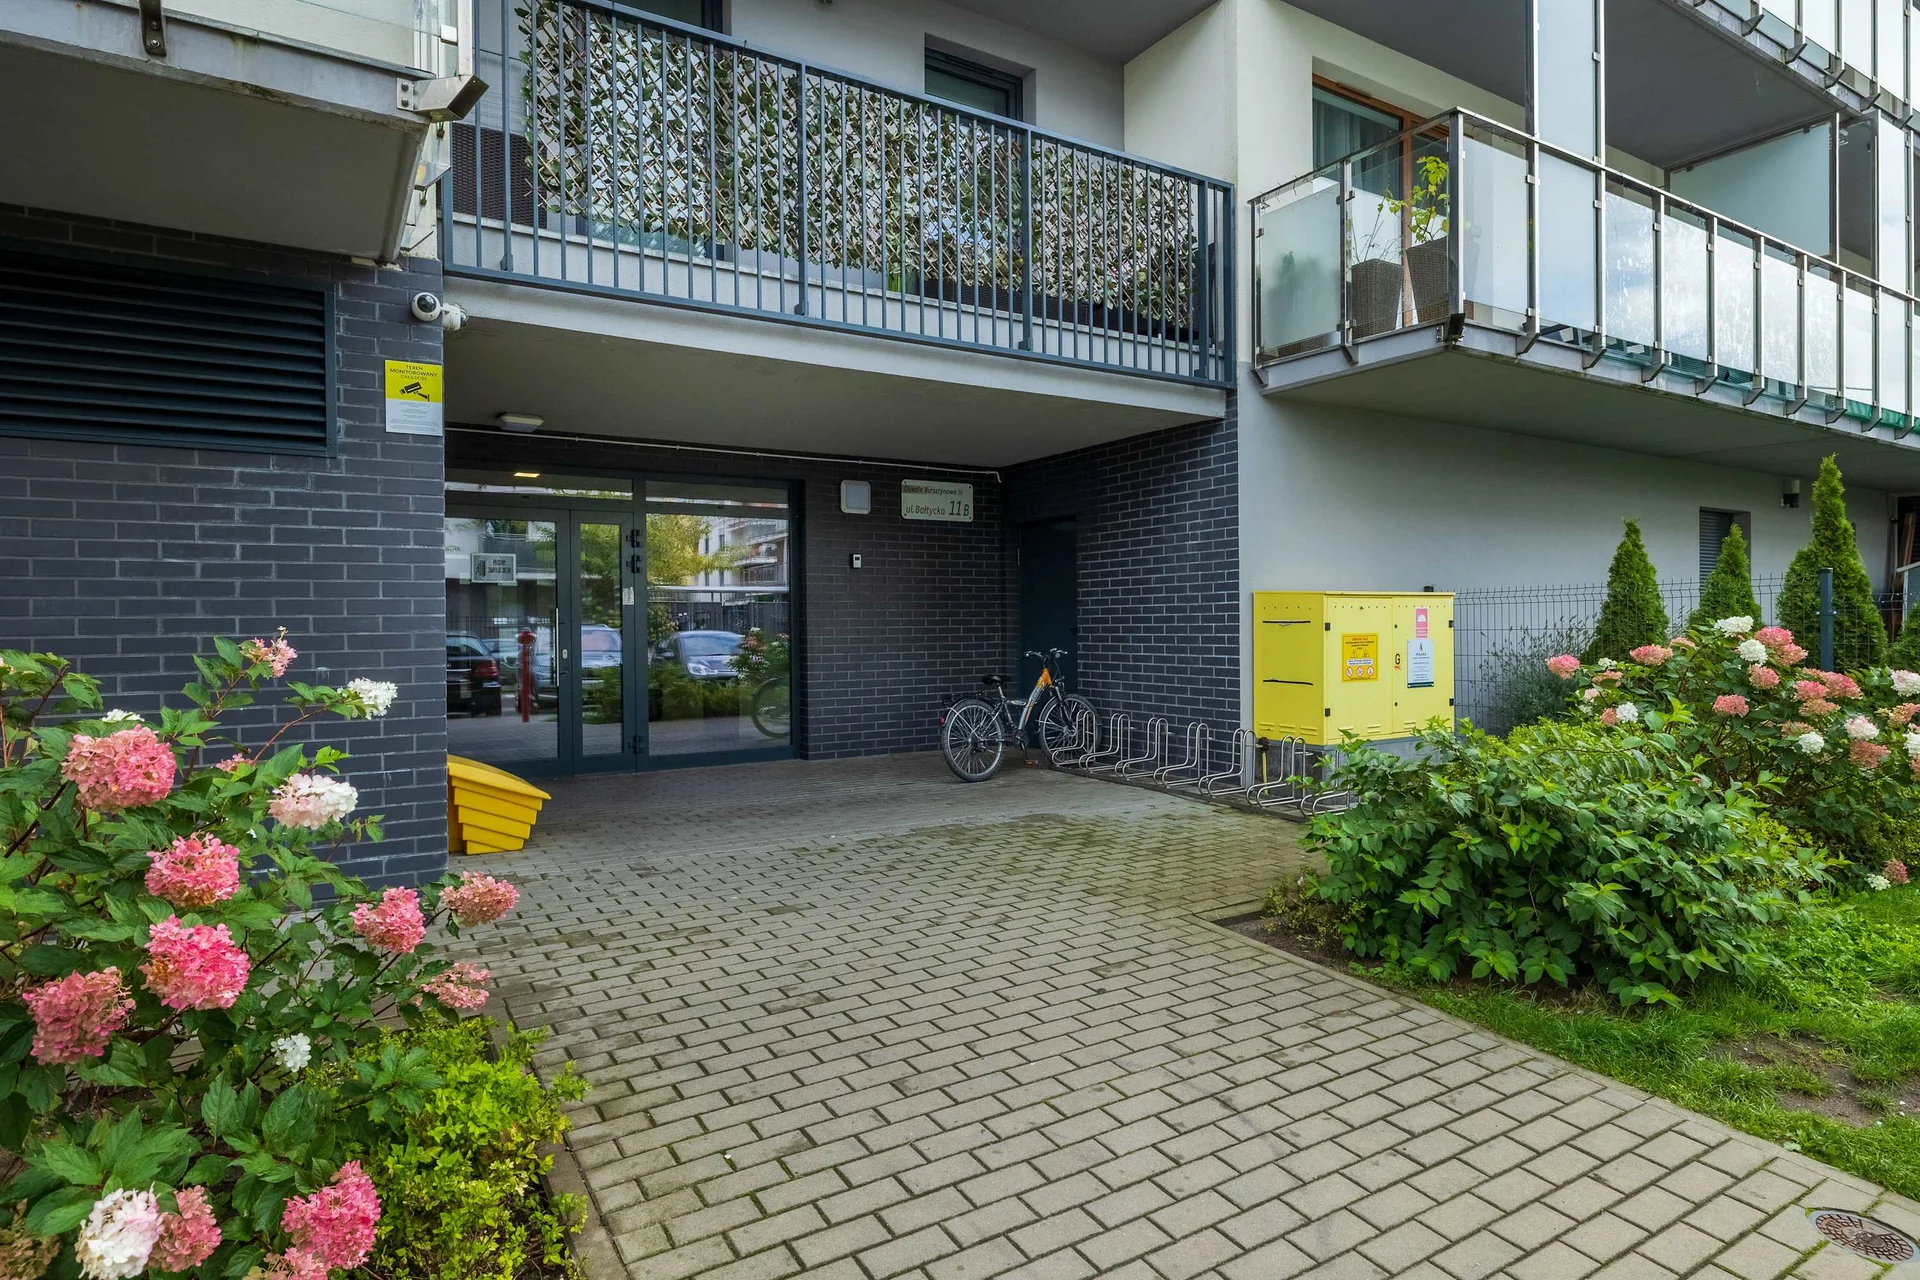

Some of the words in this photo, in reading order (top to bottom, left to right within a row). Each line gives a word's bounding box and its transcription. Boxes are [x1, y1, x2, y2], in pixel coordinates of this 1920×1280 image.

[390, 368, 438, 377] MONITOROWANY
[904, 485, 924, 493] Osiedle
[924, 486, 956, 496] Bursztynowe
[1395, 653, 1400, 664] G
